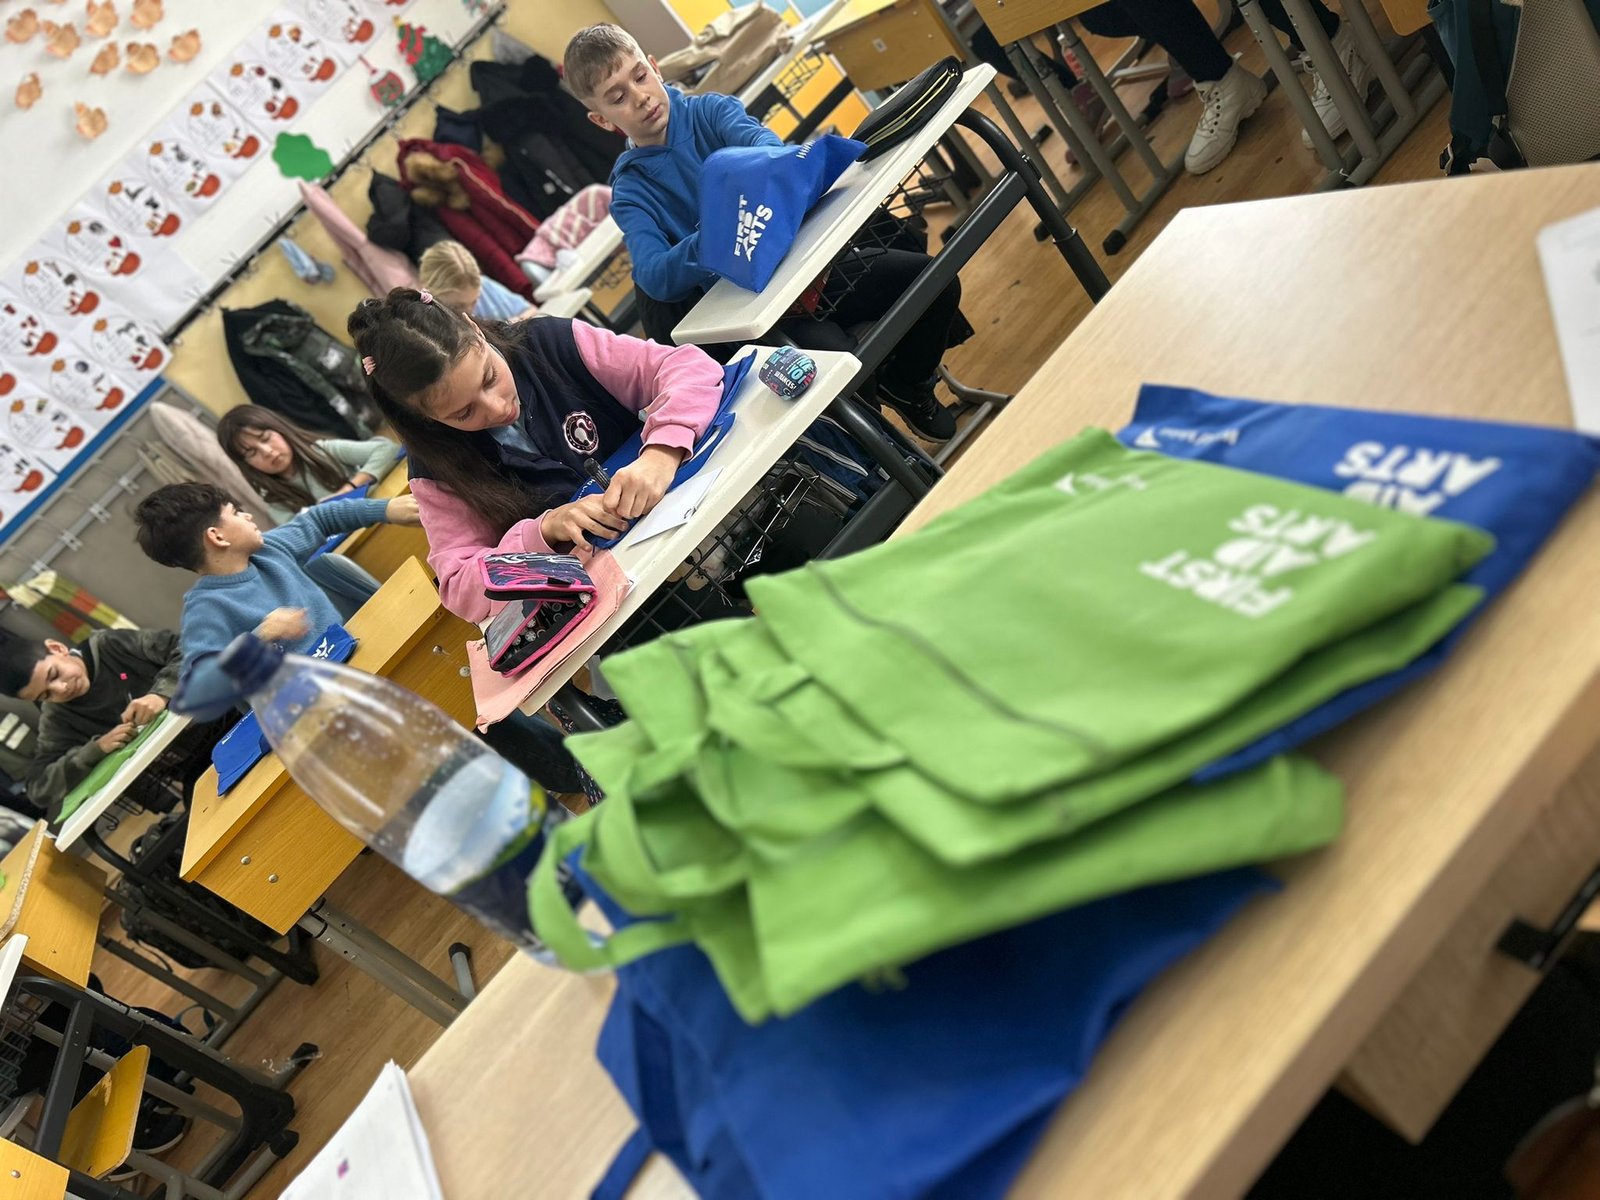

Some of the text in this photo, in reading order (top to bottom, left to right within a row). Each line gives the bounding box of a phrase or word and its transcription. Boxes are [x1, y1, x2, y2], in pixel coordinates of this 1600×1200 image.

[734, 194, 748, 256] FIRST
[746, 204, 773, 262] ARTS
[1333, 440, 1502, 497] ARTS
[1213, 536, 1320, 577] AID
[1226, 502, 1379, 559] ARTS
[1138, 549, 1295, 618] FIRST
